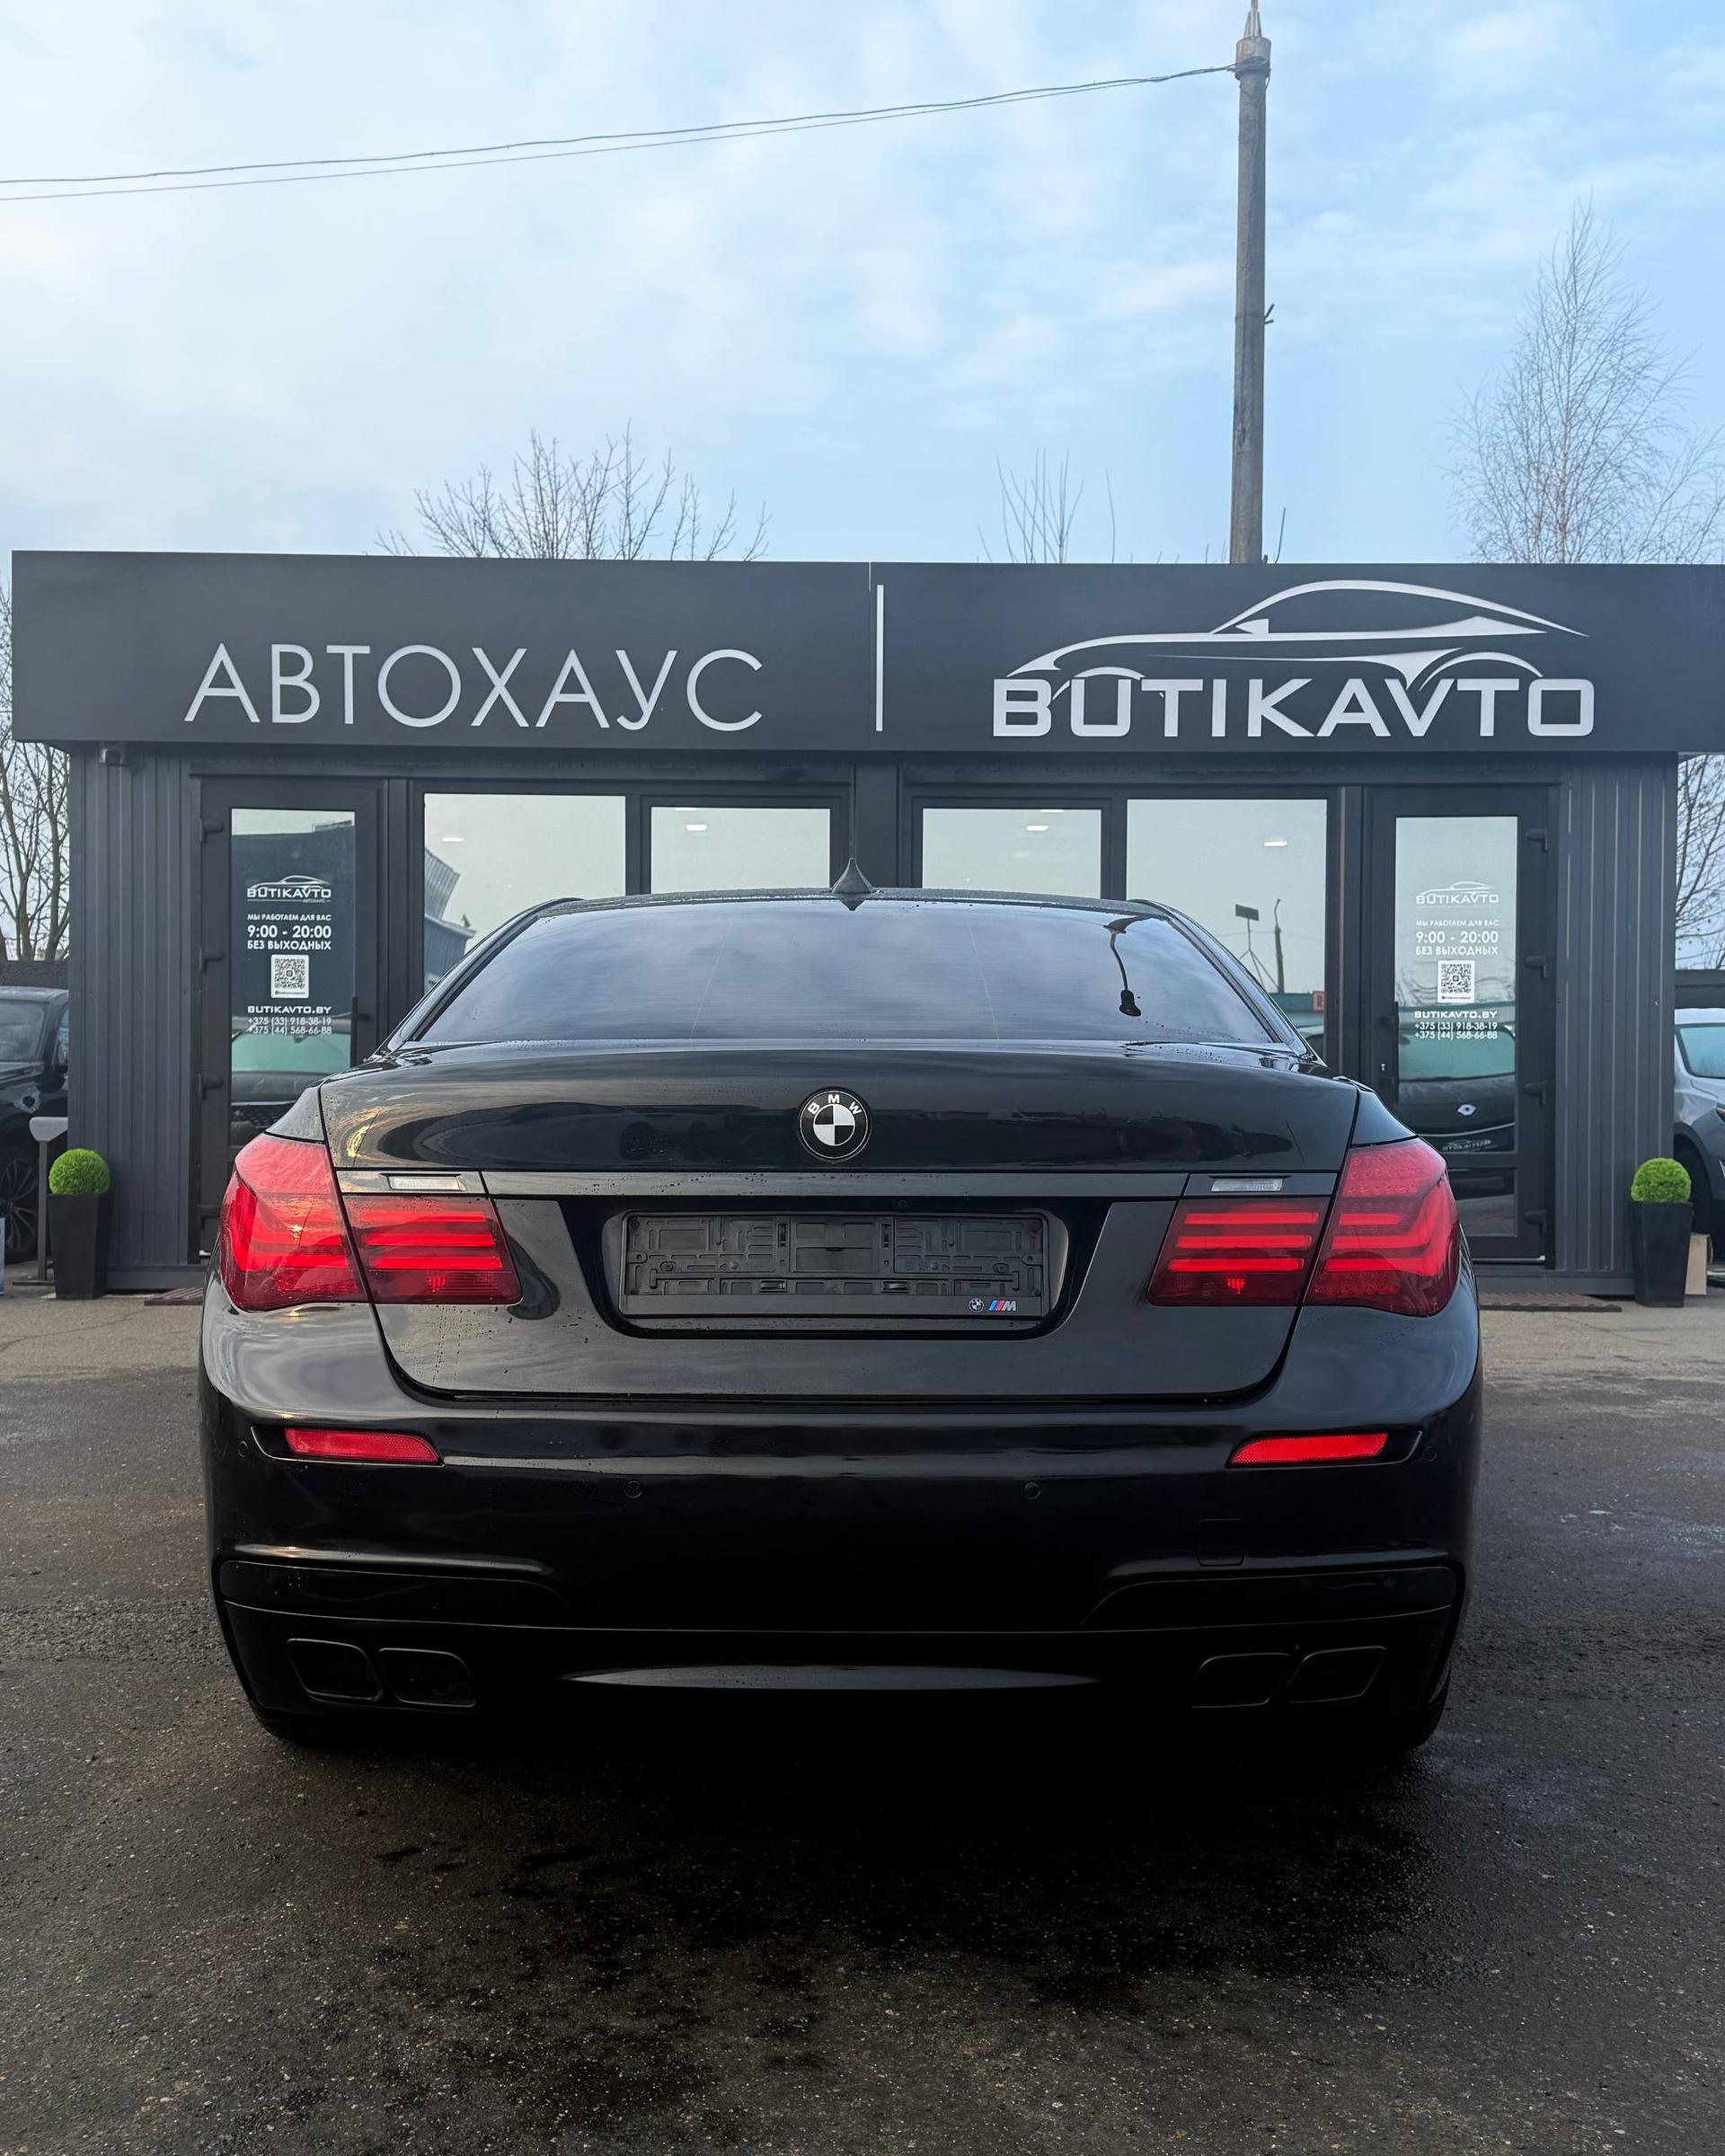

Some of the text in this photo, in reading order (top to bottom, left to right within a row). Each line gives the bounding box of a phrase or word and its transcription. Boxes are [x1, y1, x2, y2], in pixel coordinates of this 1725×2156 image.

[184, 643, 763, 731] АВТОХАУС
[993, 678, 1595, 738] BUTIKAVTO
[247, 887, 332, 898] BUTIKAVTO
[1416, 894, 1499, 905] BUTIKAVTO
[247, 924, 278, 938] 9:00
[292, 924, 332, 939] 20:00
[1416, 931, 1446, 943] 9:00
[1460, 931, 1499, 943] 20:00
[247, 940, 332, 950] БЕЗ ВЫХОДНЫХ
[1415, 946, 1499, 956] БЕЗ ВЫХОДНЫХ
[247, 1005, 332, 1014] BUTIKAVTO.BY
[1414, 1011, 1498, 1020] BUTIKAVTO.BY
[248, 1016, 332, 1027] +375 (33) 918-38-19
[1415, 1021, 1498, 1032] +375 (33) 918-38-19
[271, 1025, 288, 1036] (44)
[289, 1026, 332, 1036] 568-66-88
[1415, 1030, 1498, 1041] +375 (44) 568-66-88
[807, 1093, 862, 1115] BMW
